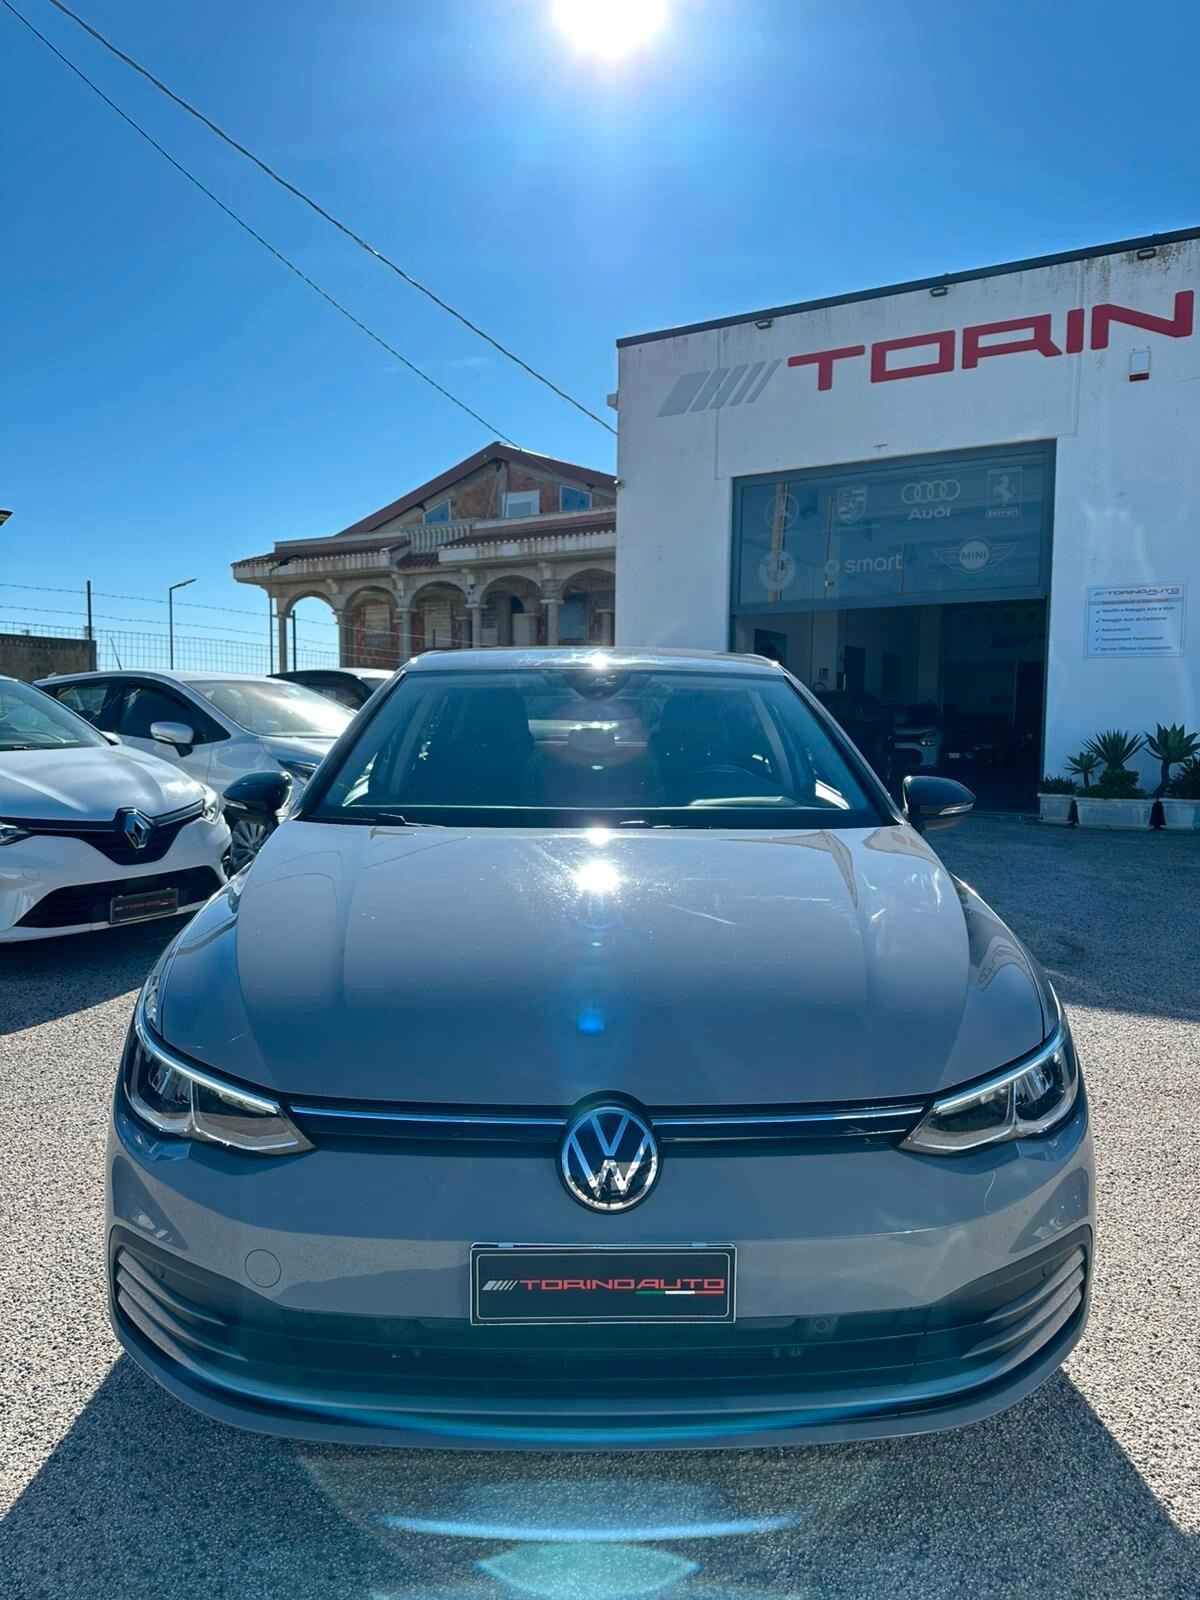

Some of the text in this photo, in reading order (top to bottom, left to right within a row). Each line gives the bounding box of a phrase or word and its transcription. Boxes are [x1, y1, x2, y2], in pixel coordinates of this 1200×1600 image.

[788, 290, 1194, 391] TORIN
[907, 506, 951, 520] Audi
[845, 552, 903, 573] smart
[961, 551, 987, 560] MINI
[519, 1278, 725, 1290] TORINOAUTO
